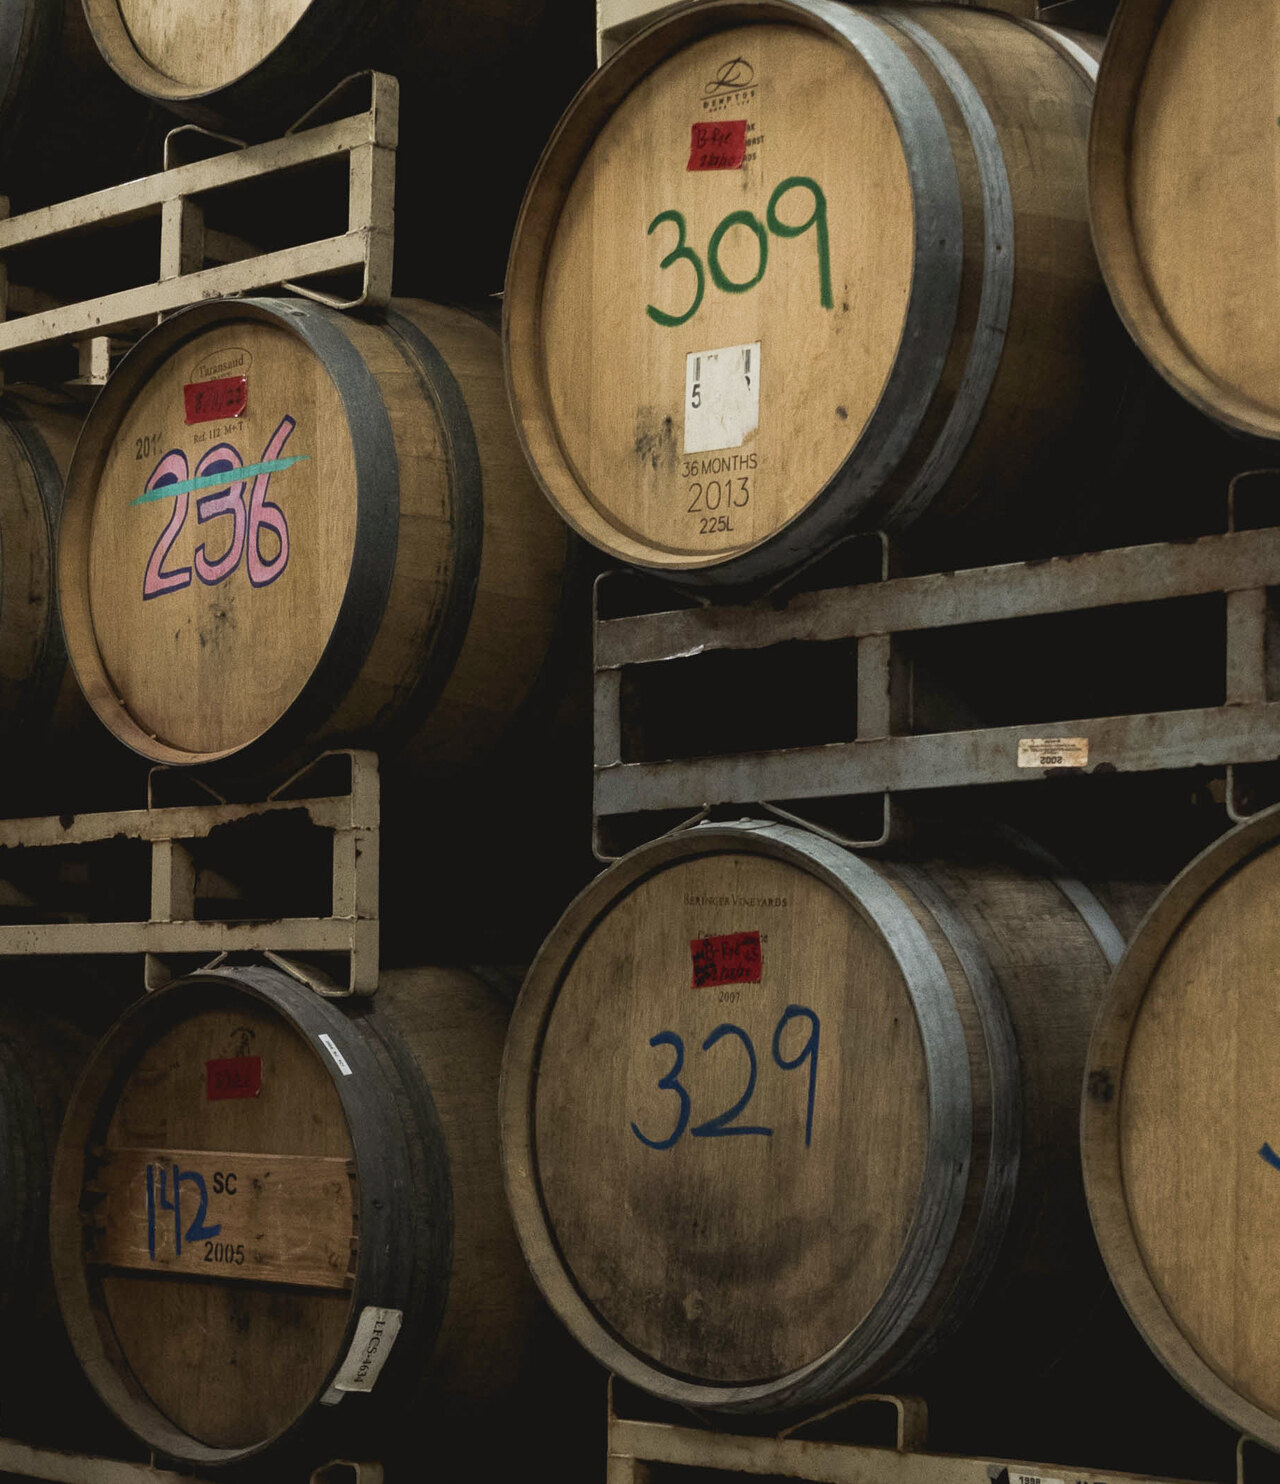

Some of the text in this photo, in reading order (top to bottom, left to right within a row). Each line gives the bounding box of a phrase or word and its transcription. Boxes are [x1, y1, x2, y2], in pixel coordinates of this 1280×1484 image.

[646, 176, 834, 327] 309
[681, 453, 758, 479] 36 MONTHS
[143, 414, 296, 602] 236
[687, 476, 751, 514] 2013
[699, 515, 734, 535] 225L
[630, 1003, 821, 1152] 329
[213, 1172, 238, 1195] SC
[146, 1163, 222, 1262] 142
[203, 1241, 246, 1265] 2005
